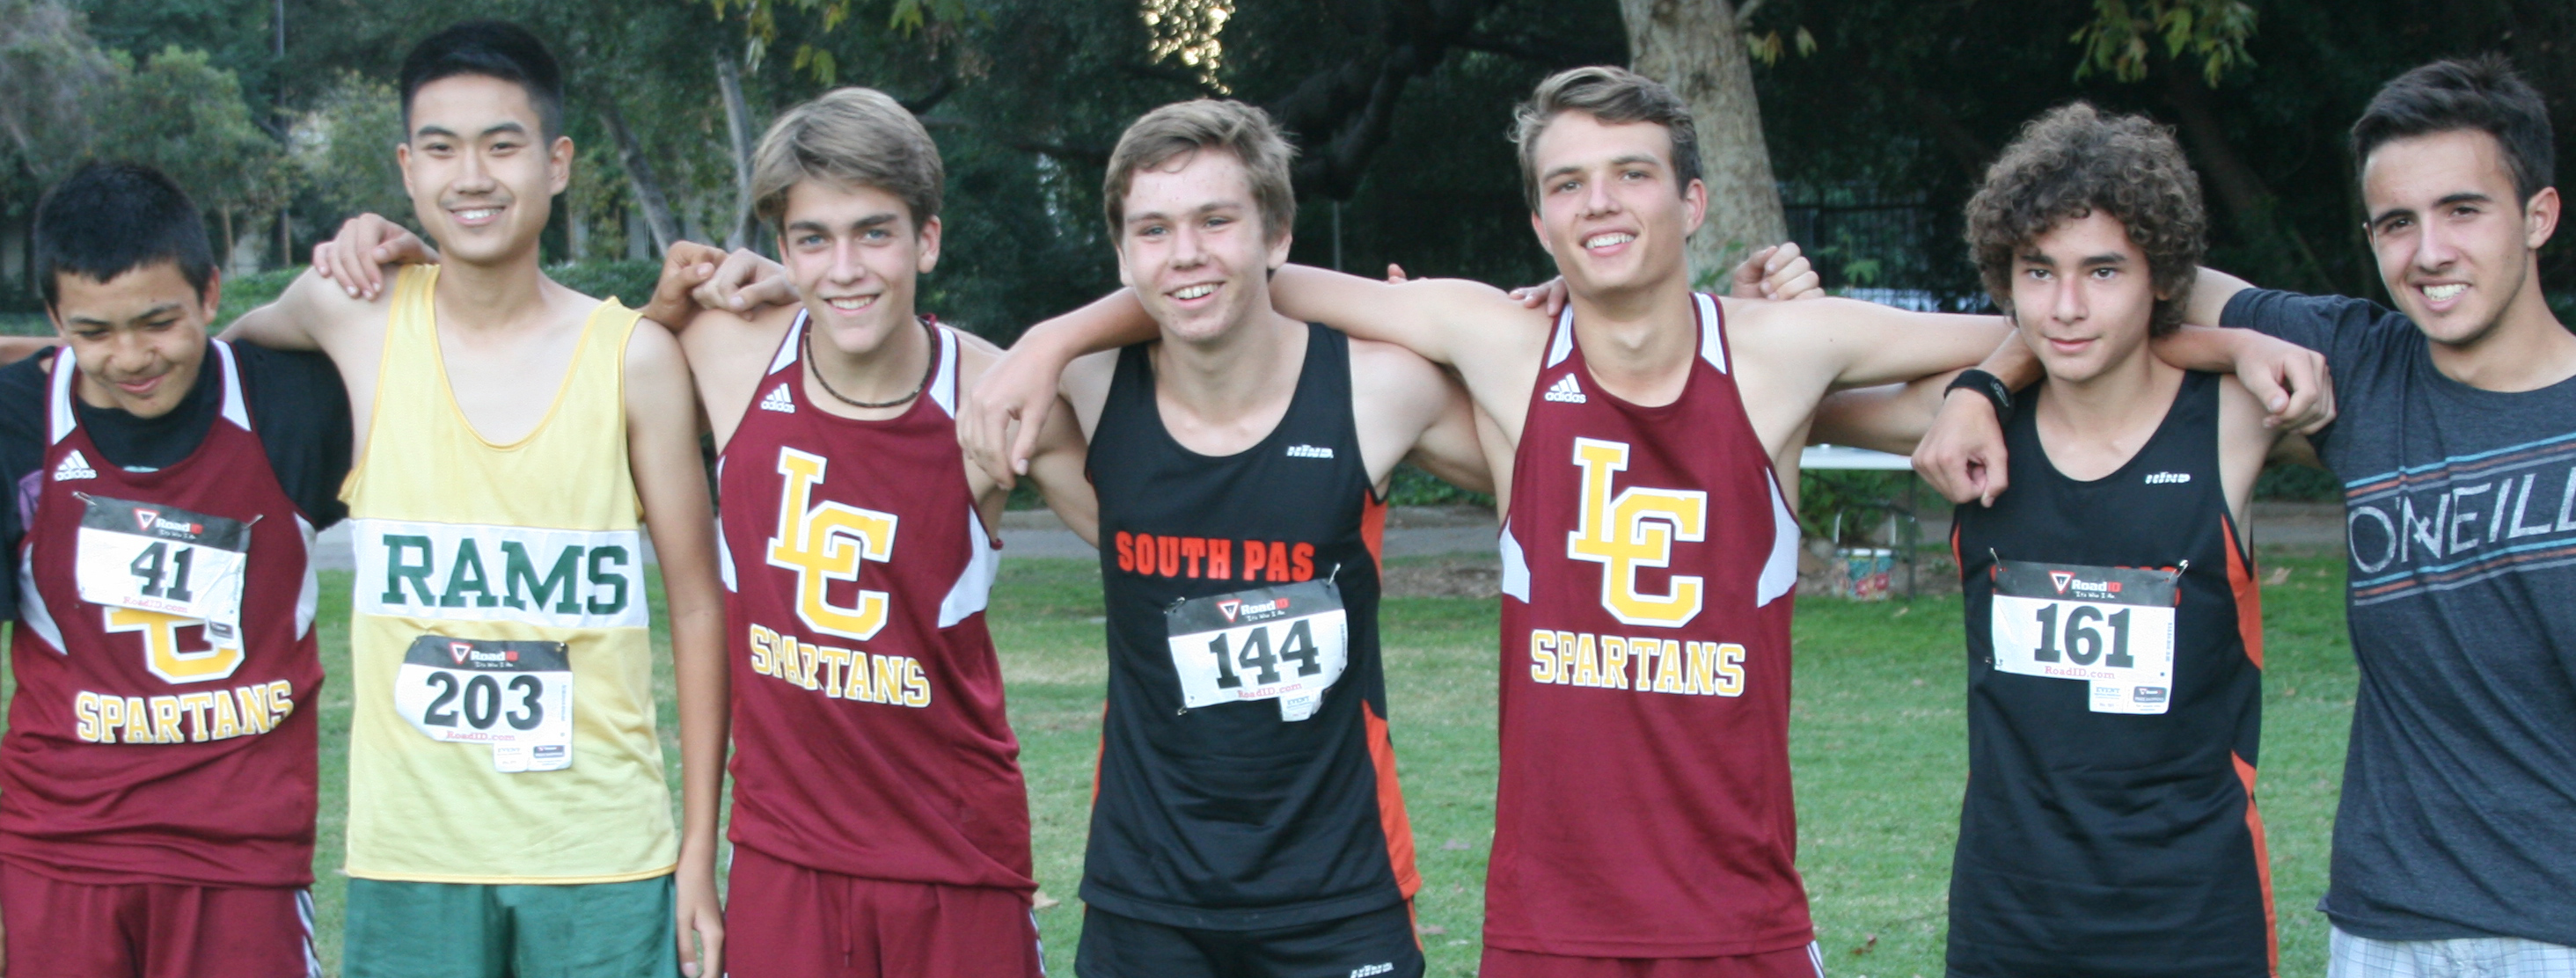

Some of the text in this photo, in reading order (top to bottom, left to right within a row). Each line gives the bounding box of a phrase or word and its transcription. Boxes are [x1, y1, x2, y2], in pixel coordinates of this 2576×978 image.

[760, 400, 795, 413] adidas
[1545, 390, 1586, 404] adidas
[55, 470, 97, 482] adidas
[766, 446, 898, 641] LC
[1115, 530, 1315, 582] SOUTH PAS
[1567, 436, 1708, 628] LC
[130, 542, 194, 602] 41
[382, 534, 629, 615] RAMS
[750, 623, 932, 707] SPARTANS
[1208, 618, 1321, 690] 144
[1531, 629, 1745, 697] SPARTANS
[2034, 602, 2134, 669] 161
[424, 671, 544, 731] 203
[1238, 683, 1302, 698] RoadID.com
[2045, 666, 2116, 680] RoadID.com
[77, 679, 294, 743] SPARTANS
